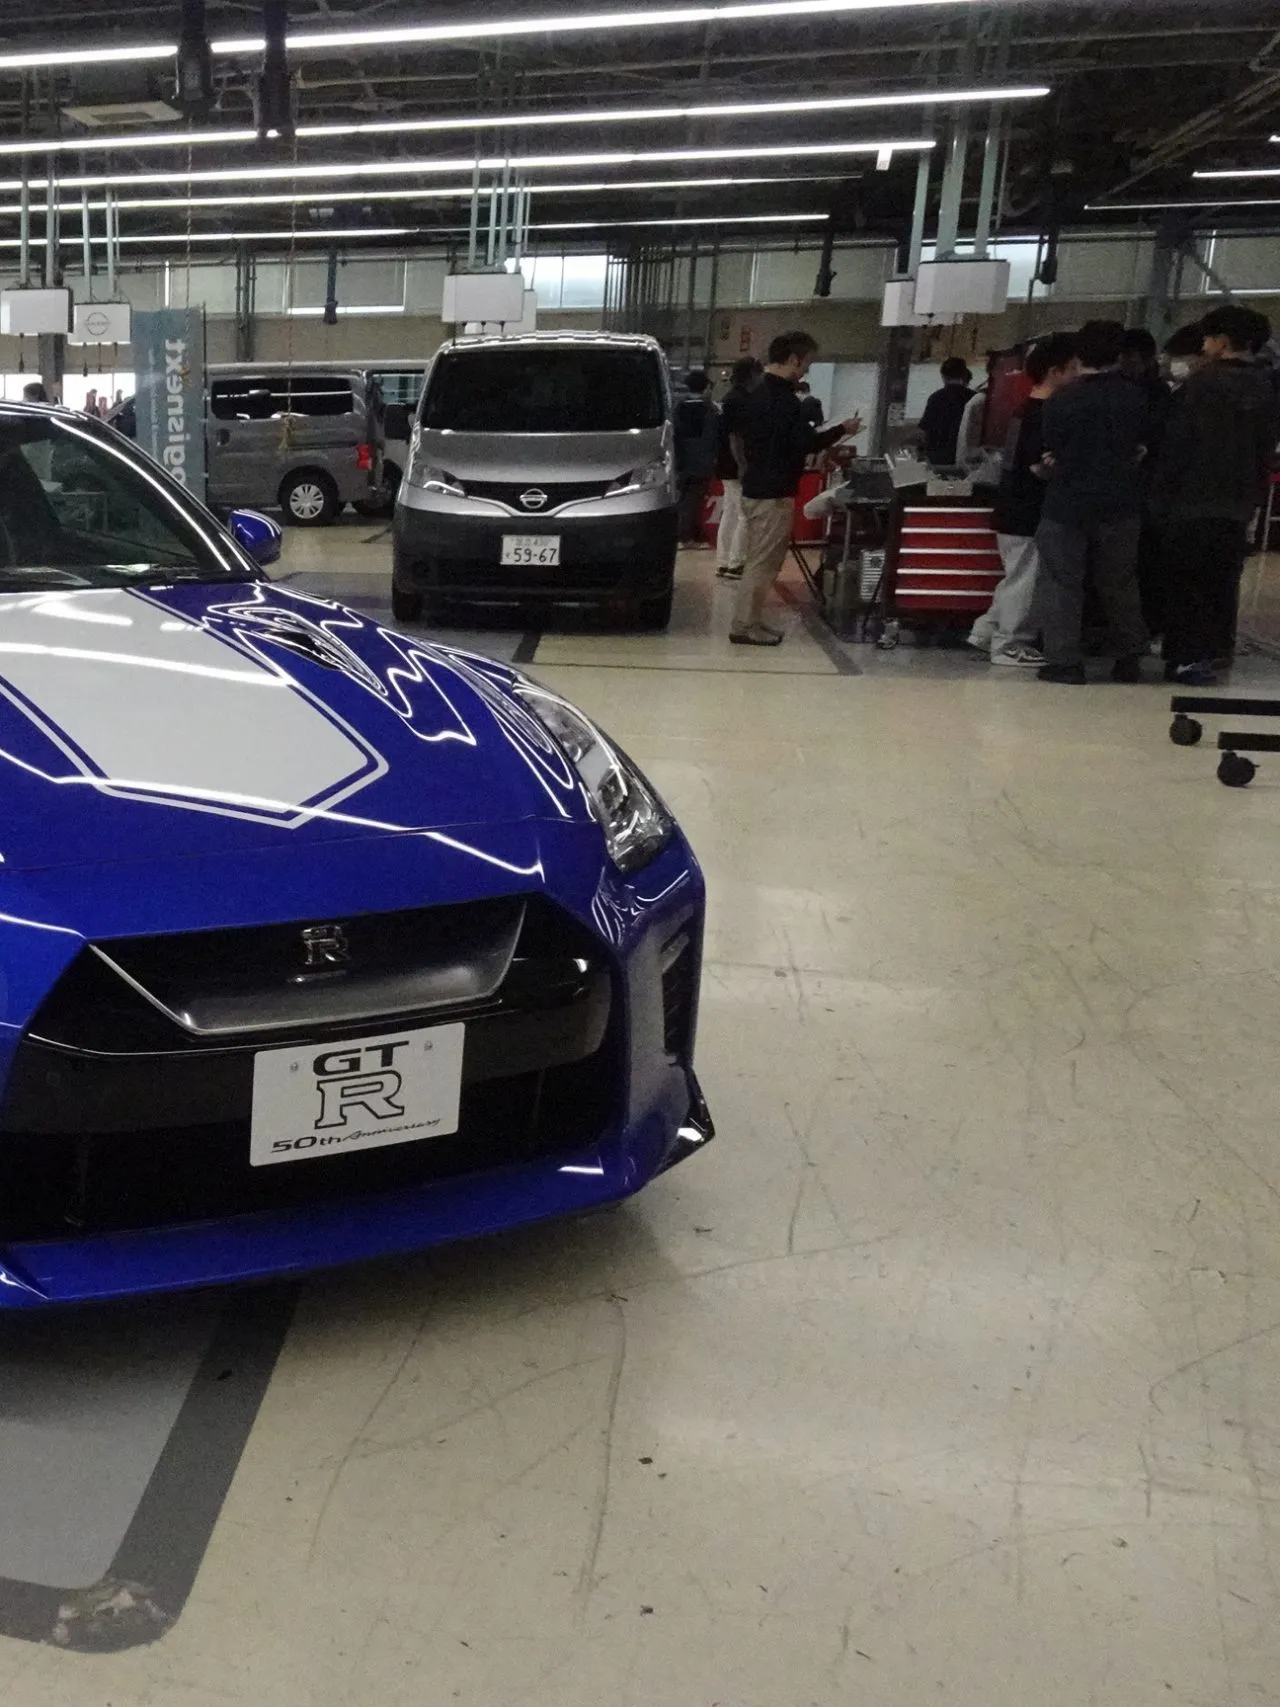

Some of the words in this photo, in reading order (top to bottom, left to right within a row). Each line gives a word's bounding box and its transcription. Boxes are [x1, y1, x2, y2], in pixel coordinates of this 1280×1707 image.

[513, 548, 557, 562] 59-67
[313, 1041, 410, 1077] GT
[314, 1069, 405, 1130] R
[271, 1136, 341, 1153] 50th
